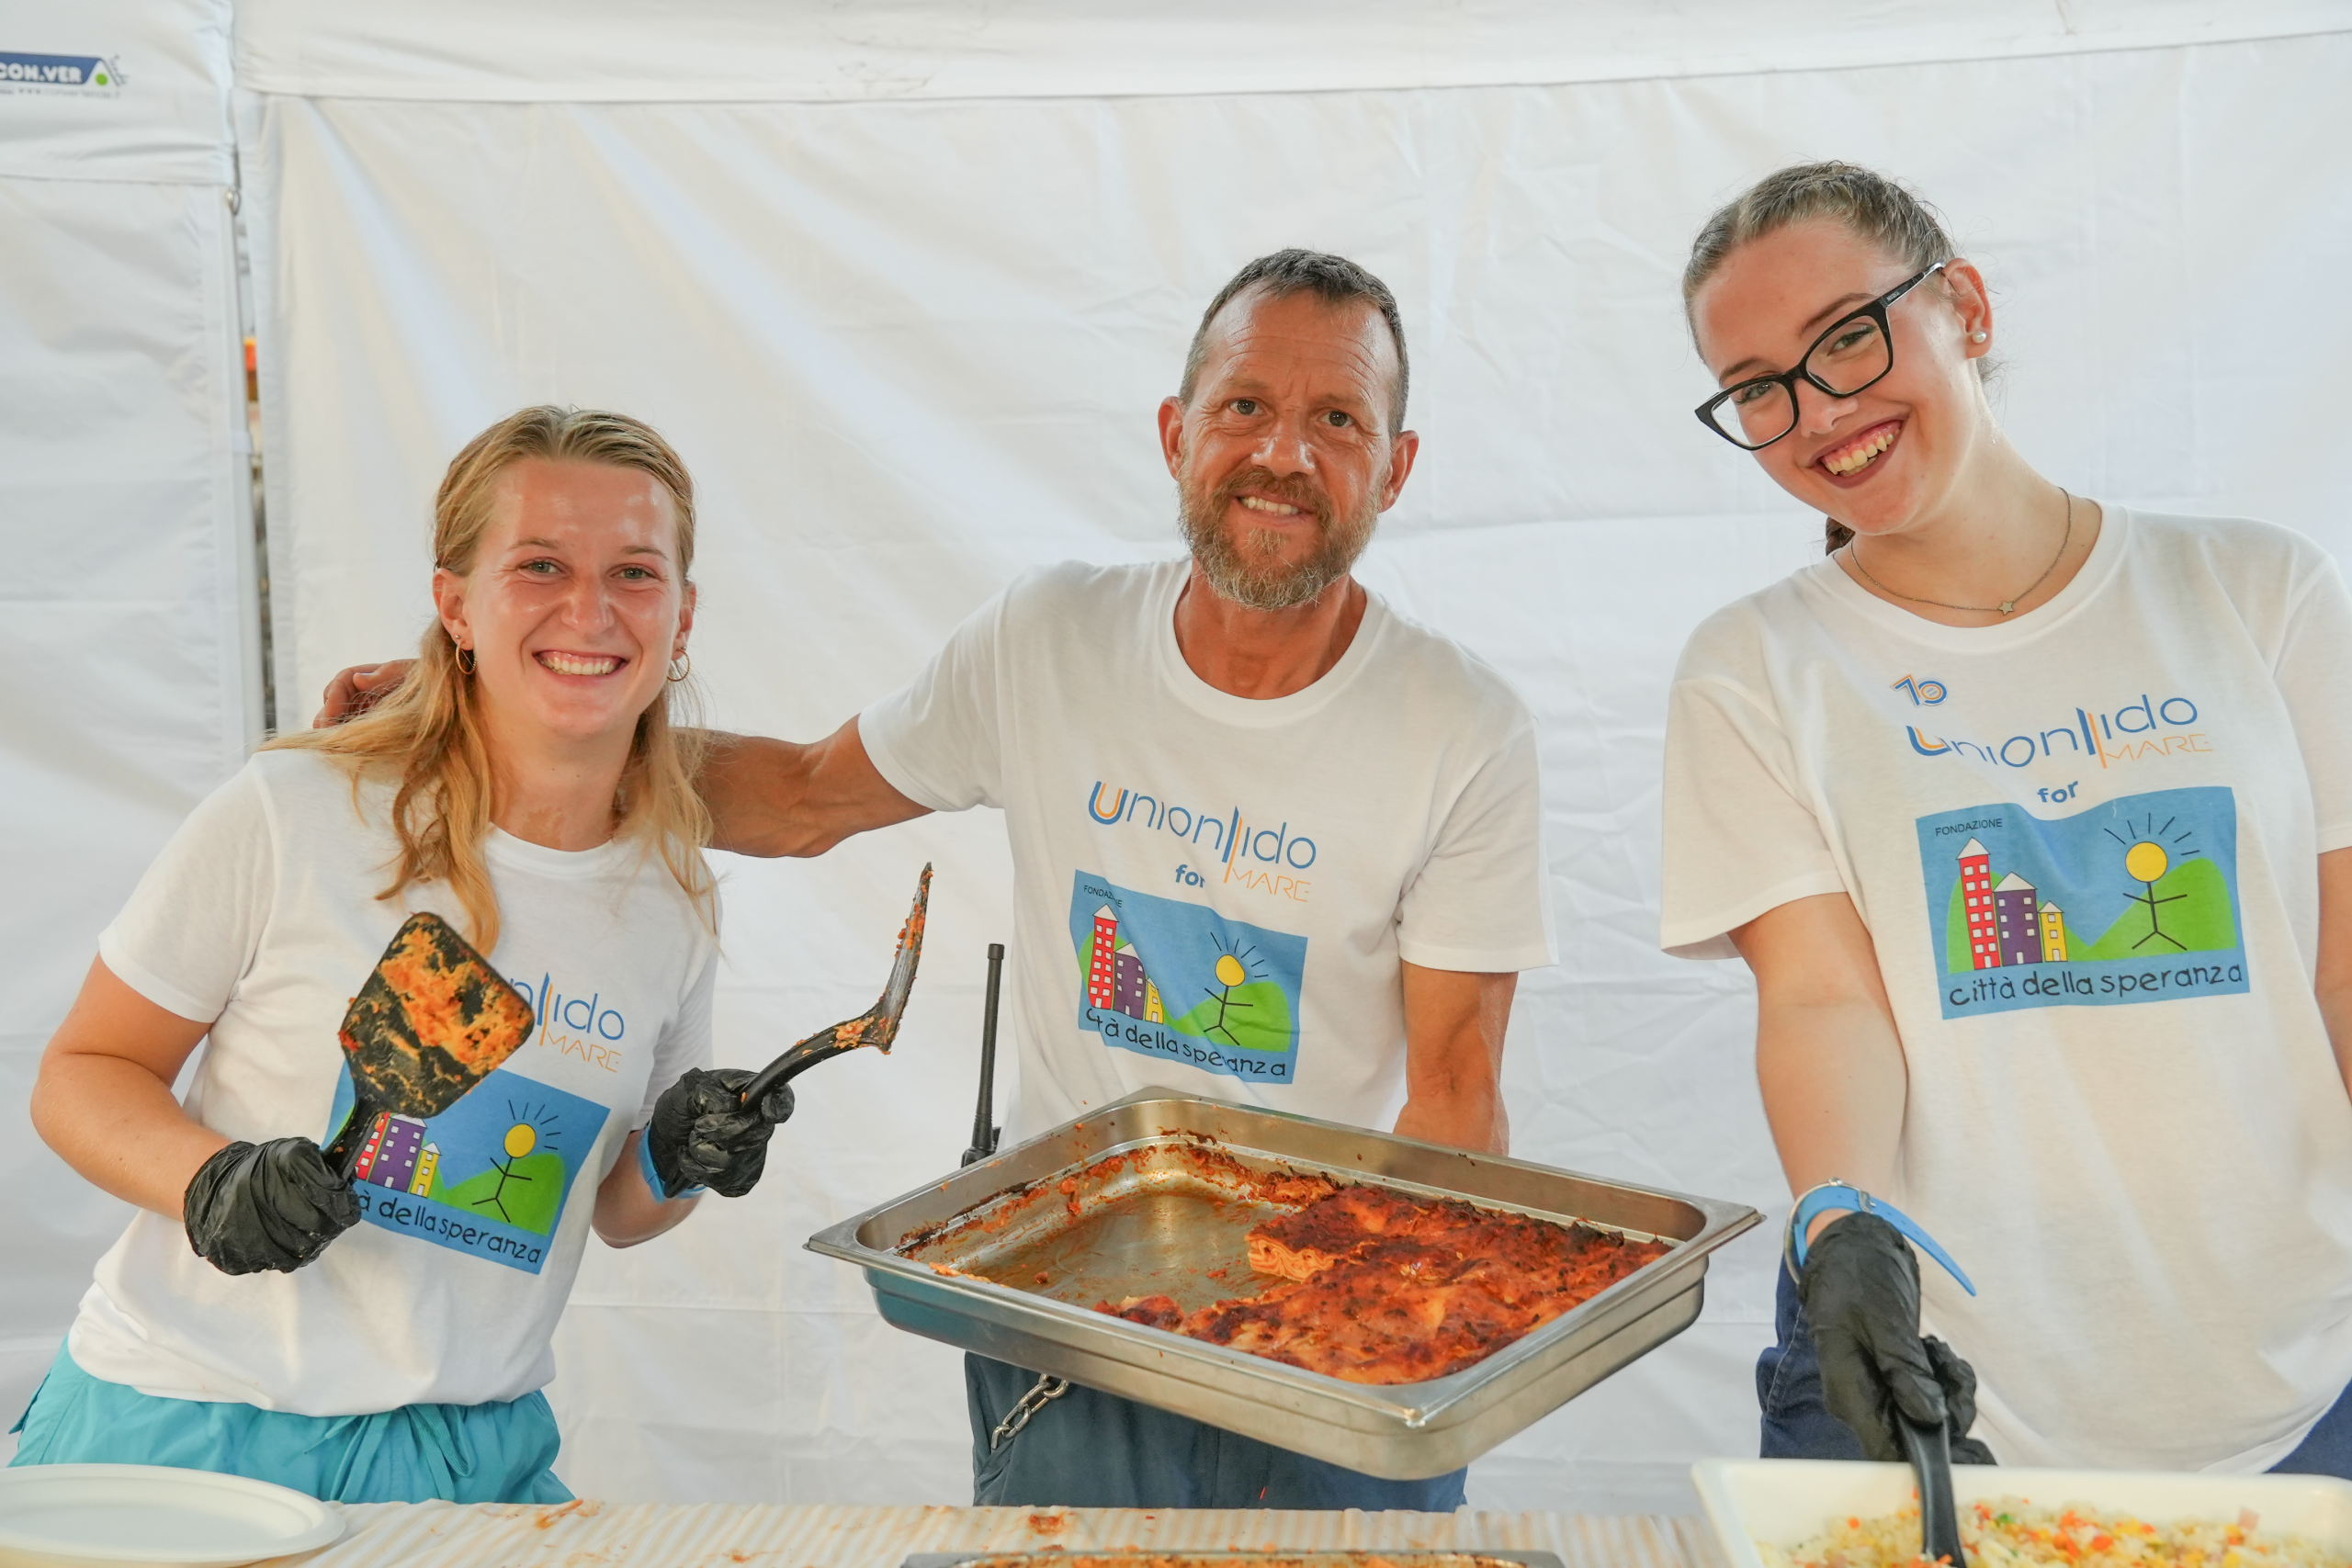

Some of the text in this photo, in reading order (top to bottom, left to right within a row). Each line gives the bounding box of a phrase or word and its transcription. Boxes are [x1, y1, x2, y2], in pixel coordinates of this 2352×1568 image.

[2106, 733, 2213, 761] MARE
[2037, 781, 2079, 804] for
[1935, 818, 2003, 837] FONDAZIONE
[1175, 863, 1205, 889] for
[1233, 867, 1311, 902] MARE
[1949, 976, 2016, 1007] città
[2100, 964, 2243, 998] speranza
[547, 1031, 622, 1073] MARE
[1182, 1043, 1286, 1077] speanza
[438, 1218, 542, 1265] speranza
